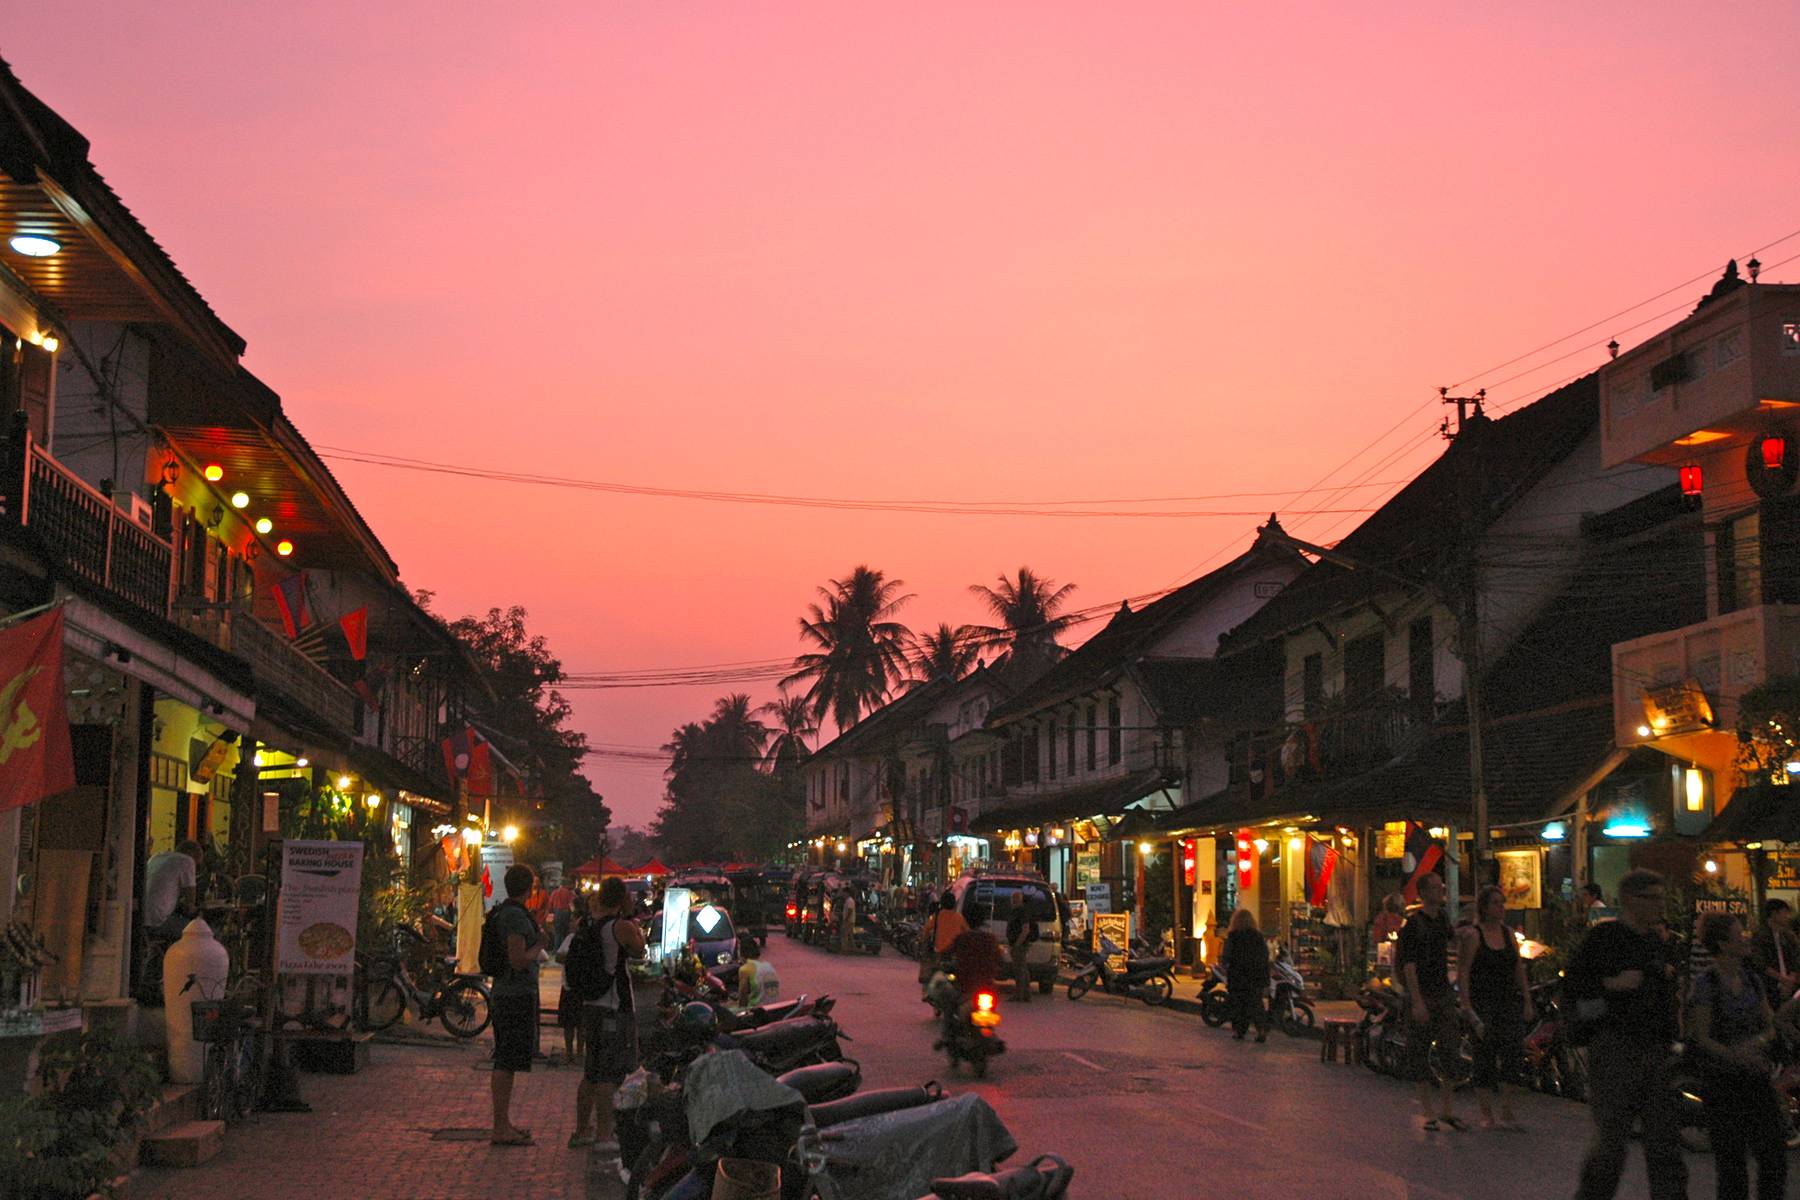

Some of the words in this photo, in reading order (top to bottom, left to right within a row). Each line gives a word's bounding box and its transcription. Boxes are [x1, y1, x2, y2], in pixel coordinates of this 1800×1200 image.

[289, 847, 329, 856] SWEDISH
[289, 859, 322, 868] BAKING
[324, 860, 354, 869] HOUSE
[1728, 901, 1748, 914] SPA
